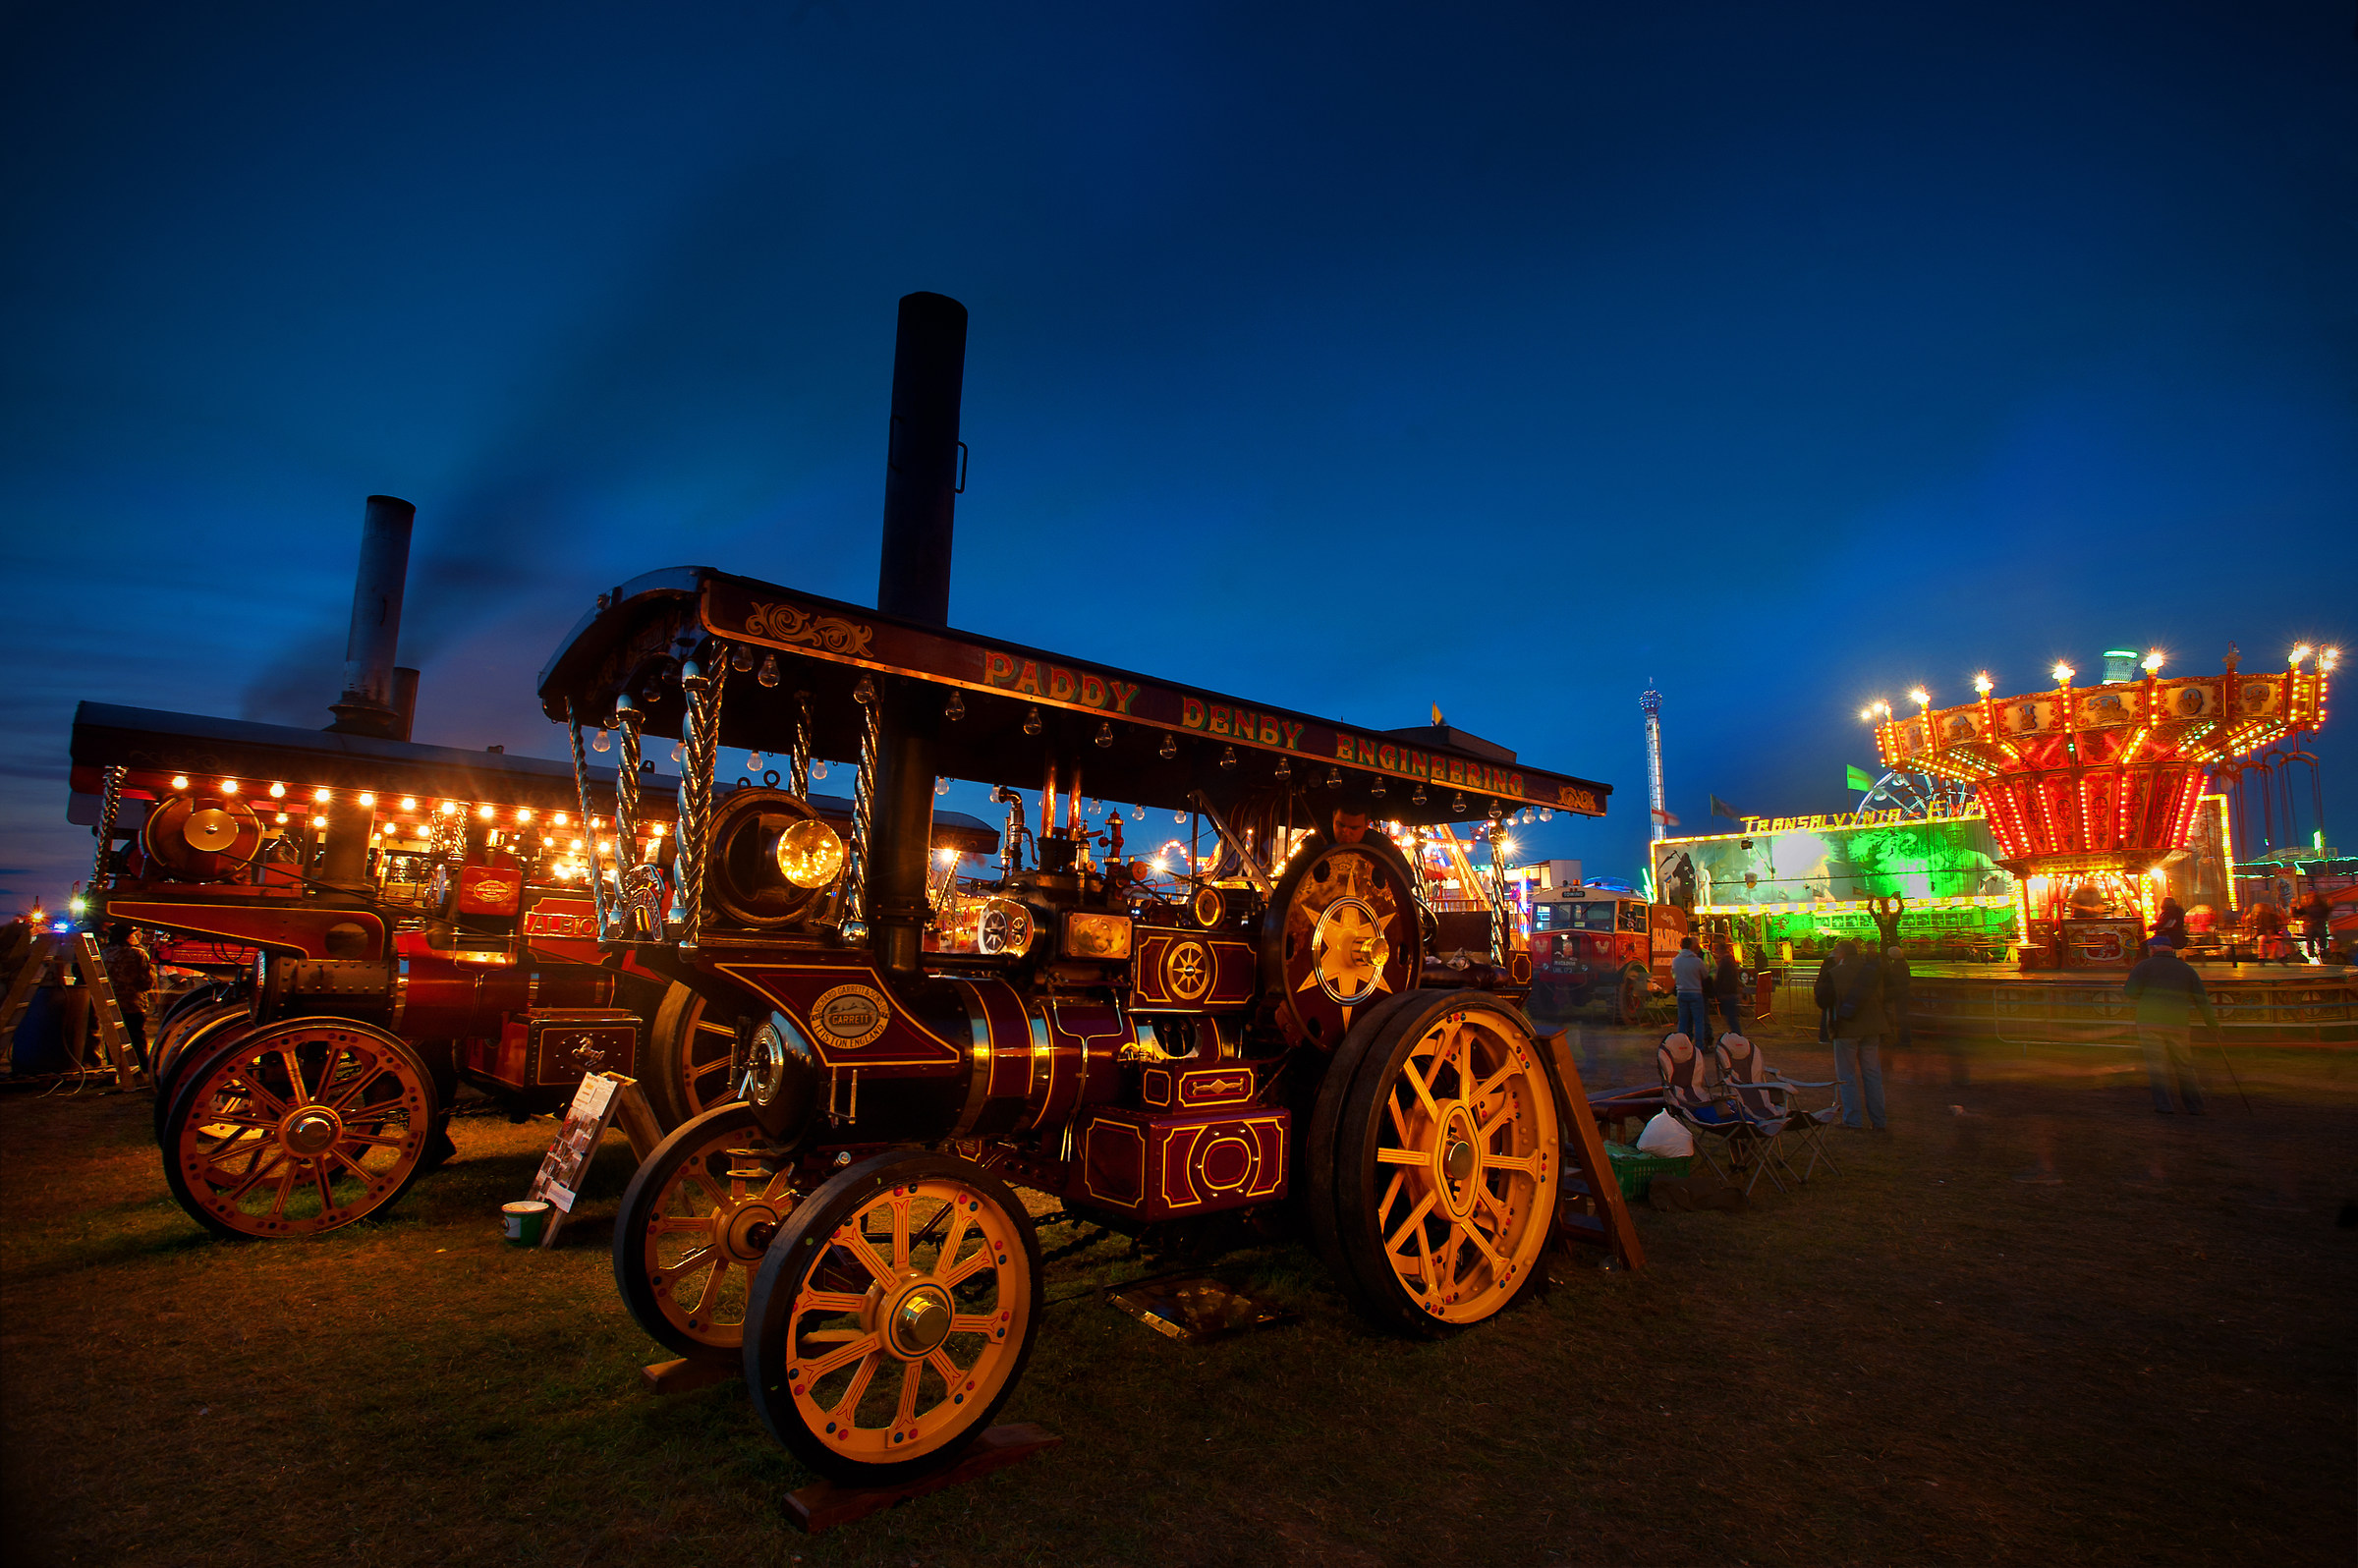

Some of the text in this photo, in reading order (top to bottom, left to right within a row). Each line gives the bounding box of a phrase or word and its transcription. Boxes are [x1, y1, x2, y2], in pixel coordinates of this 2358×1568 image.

[982, 650, 1524, 797] PADDY DENBY ENGINEERING
[1740, 808, 1902, 832] TRANSALVYNIA
[1927, 796, 1983, 819] EXP
[530, 916, 597, 934] ALBIO
[814, 989, 837, 1013] RICHARD
[837, 984, 865, 995] GARRETT
[869, 989, 884, 1006] SONS
[832, 1014, 870, 1025] GARRETT
[814, 1024, 884, 1048] LEISTON ENGLAND
